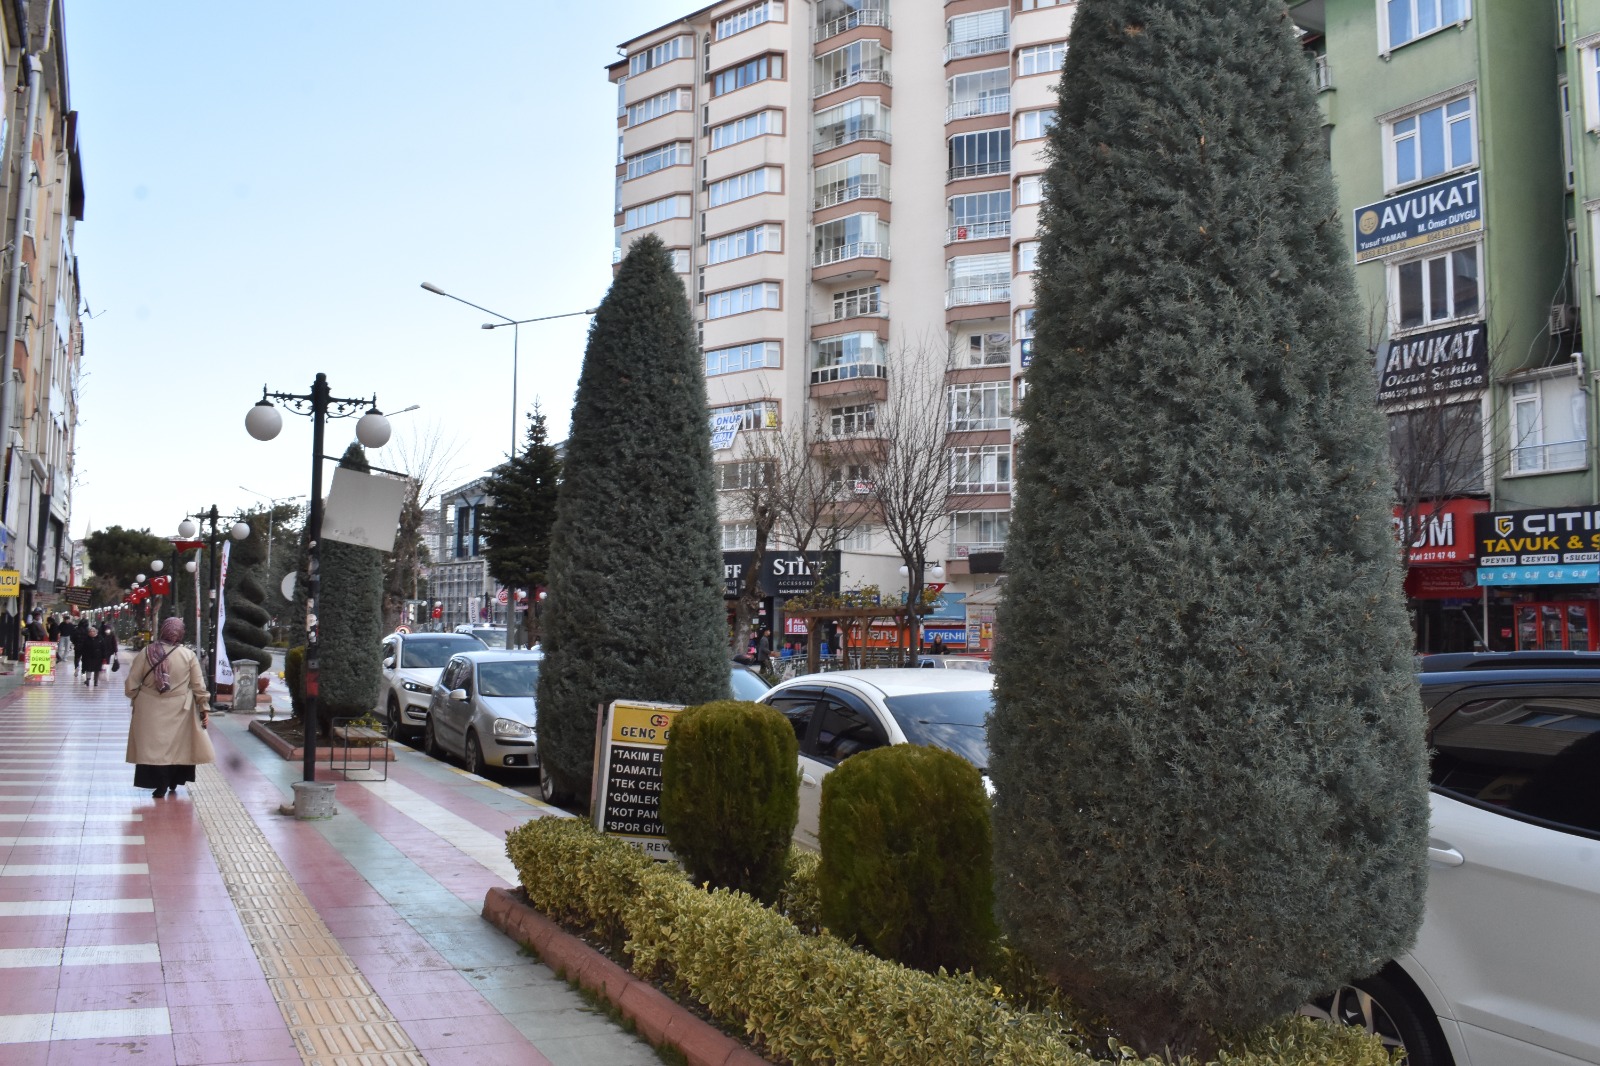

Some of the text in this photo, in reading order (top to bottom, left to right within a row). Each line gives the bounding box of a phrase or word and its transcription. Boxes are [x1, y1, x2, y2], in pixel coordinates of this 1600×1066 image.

[1380, 181, 1478, 230] AVUKAT
[1417, 209, 1477, 234] M. Ömer DUYGU
[1360, 231, 1407, 250] Yusuf YAMAN
[1386, 329, 1480, 373] AVUKAT
[1483, 536, 1560, 553] TAVUK
[1567, 535, 1584, 549] &
[1569, 553, 1599, 561] SUCUK
[0, 576, 18, 585] LCU
[786, 617, 793, 633] 1
[851, 627, 898, 644] tiany
[31, 664, 45, 673] 70
[621, 726, 656, 740] GENÇ
